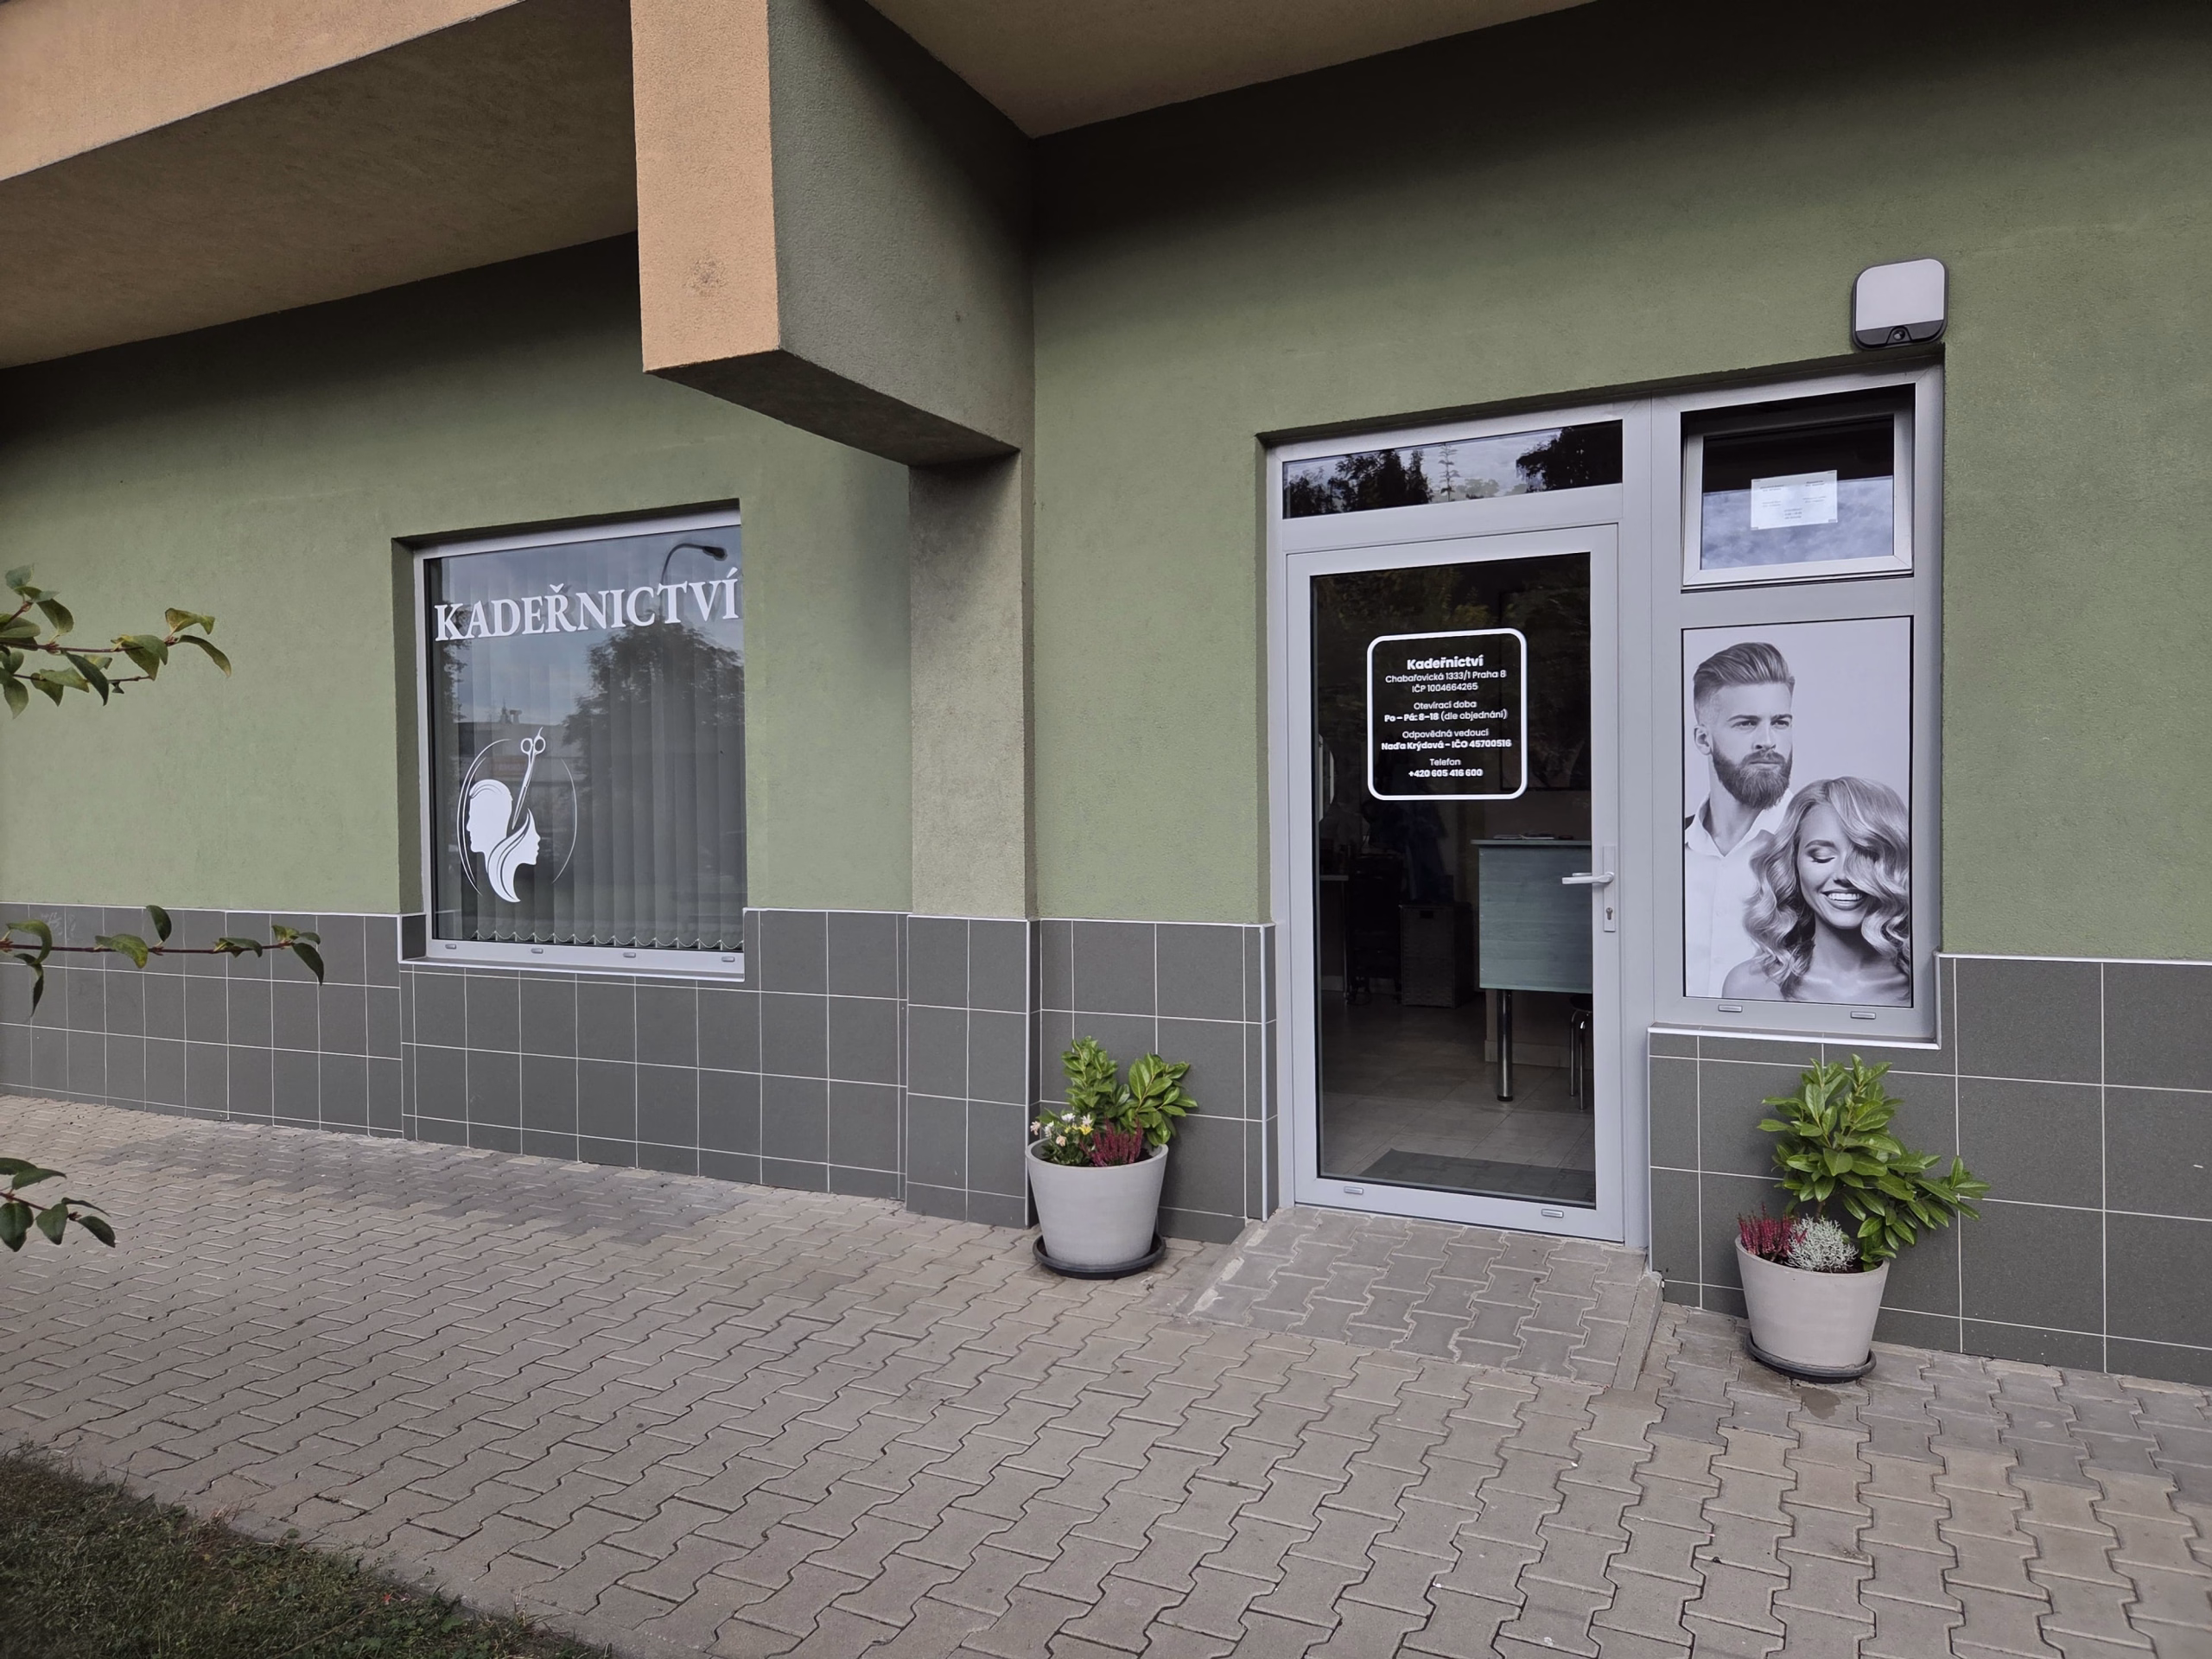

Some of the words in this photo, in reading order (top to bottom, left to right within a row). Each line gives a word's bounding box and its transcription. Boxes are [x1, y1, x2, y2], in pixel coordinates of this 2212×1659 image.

[435, 567, 739, 641] KADEŘNICTVÍ
[1407, 654, 1484, 671] Kadeřnictví
[1385, 672, 1444, 683] Chabařovická
[1446, 670, 1471, 681] 1333/1
[1472, 670, 1499, 679] Praha
[1500, 669, 1507, 678] 8
[1412, 683, 1426, 693] IČP
[1414, 701, 1452, 710] Otevírací
[1453, 700, 1478, 709] doba
[1440, 710, 1458, 721] (dle
[1459, 709, 1508, 721] objednání)
[1402, 728, 1452, 741] Odpovědná
[1454, 728, 1490, 737] vedoucí
[1452, 739, 1468, 749] IČO
[1429, 758, 1461, 766] Telefon
[1408, 769, 1430, 778] +420
[1431, 769, 1448, 778] 605
[1465, 768, 1484, 777] 600
